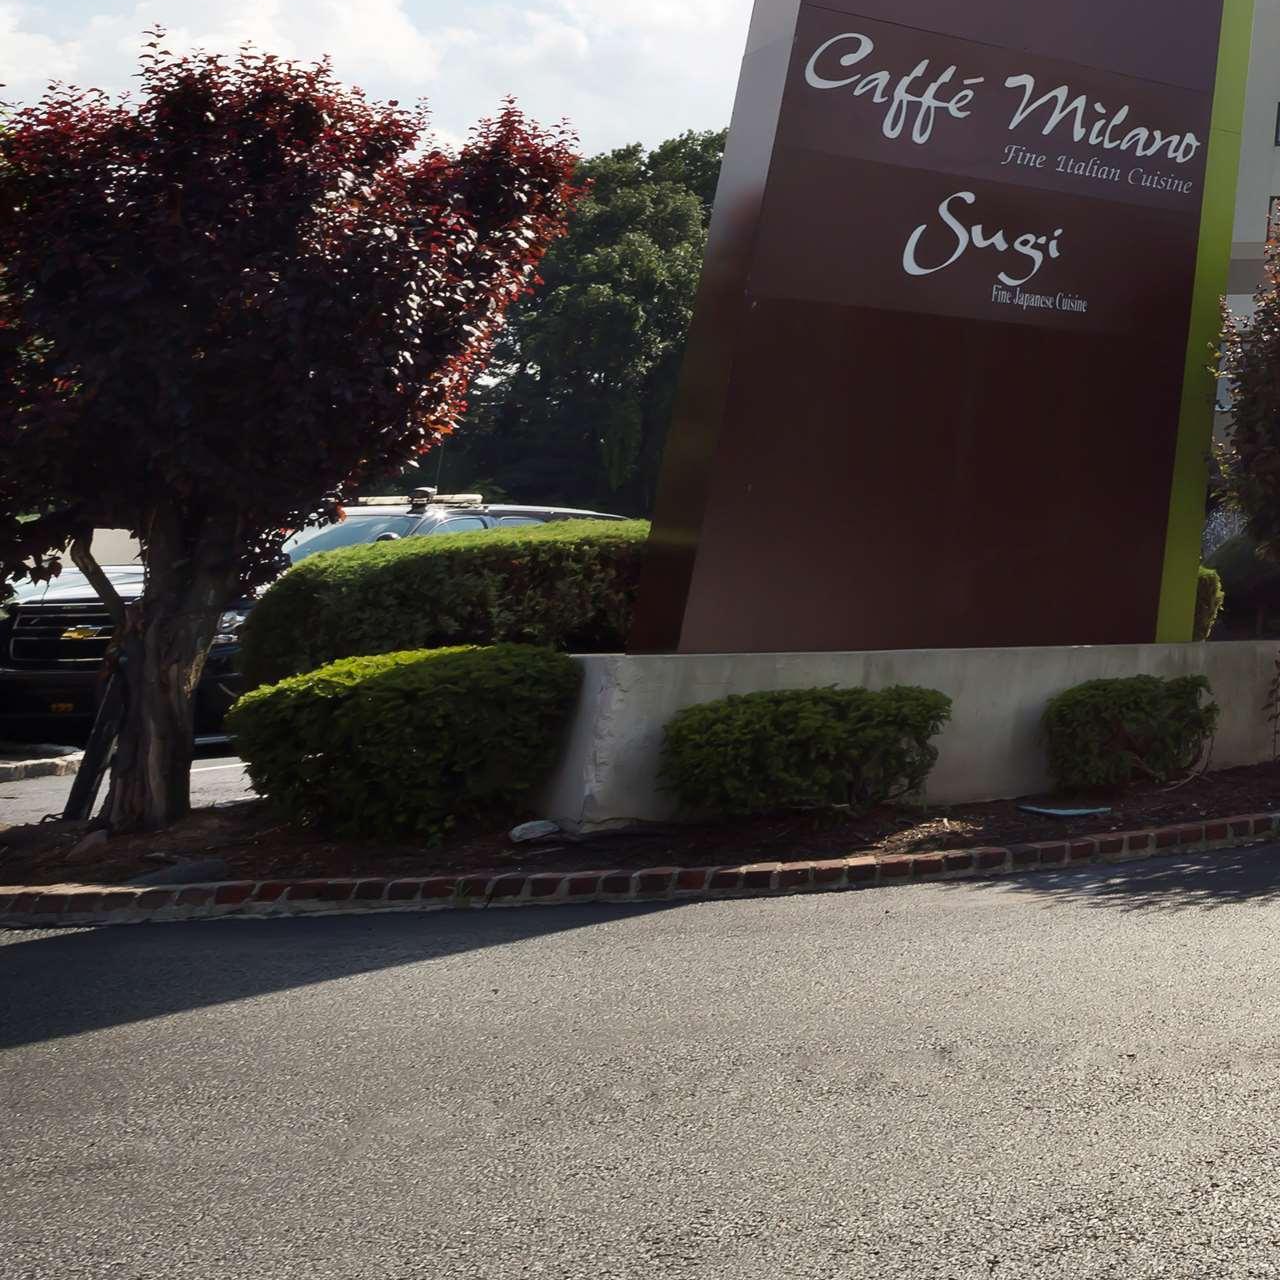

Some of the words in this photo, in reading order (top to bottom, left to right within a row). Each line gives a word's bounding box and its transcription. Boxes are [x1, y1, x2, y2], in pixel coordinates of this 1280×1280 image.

[804, 32, 985, 144] Caffé
[1004, 74, 1202, 164] Milano
[1001, 144, 1047, 169] Fine
[1055, 154, 1121, 182] Italian
[1127, 167, 1194, 194] Cuisine
[902, 191, 1063, 287] Sugi
[991, 284, 1012, 304] Fine
[1013, 286, 1055, 310] Japanese
[1056, 292, 1089, 313] Cuisine
